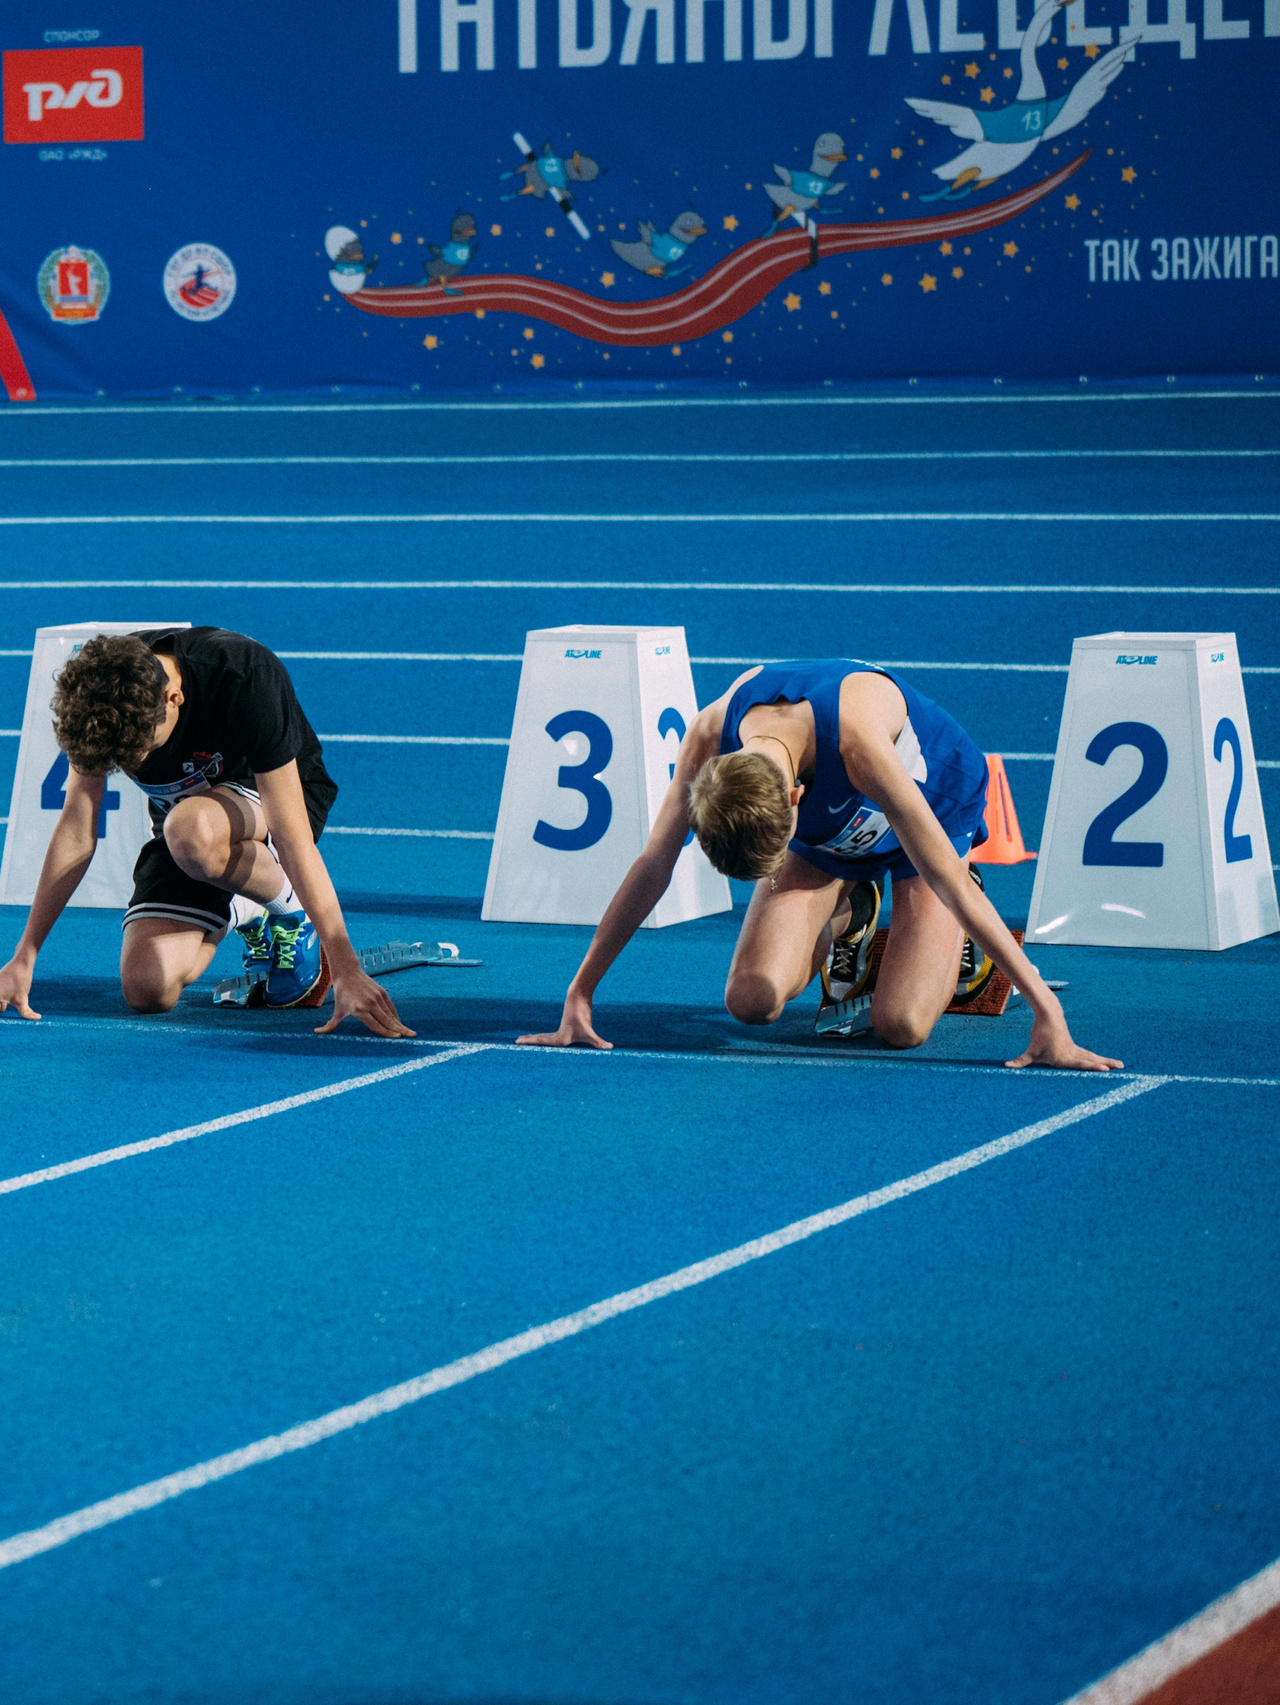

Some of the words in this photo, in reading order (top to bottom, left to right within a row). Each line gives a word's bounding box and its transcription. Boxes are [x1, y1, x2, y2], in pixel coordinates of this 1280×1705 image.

[1022, 111, 1041, 131] 13
[1084, 239, 1140, 282] ТАК
[1151, 235, 1279, 281] ЗАЖИГА
[533, 710, 613, 851] 3
[1082, 721, 1169, 868] 2
[1214, 717, 1253, 864] 2
